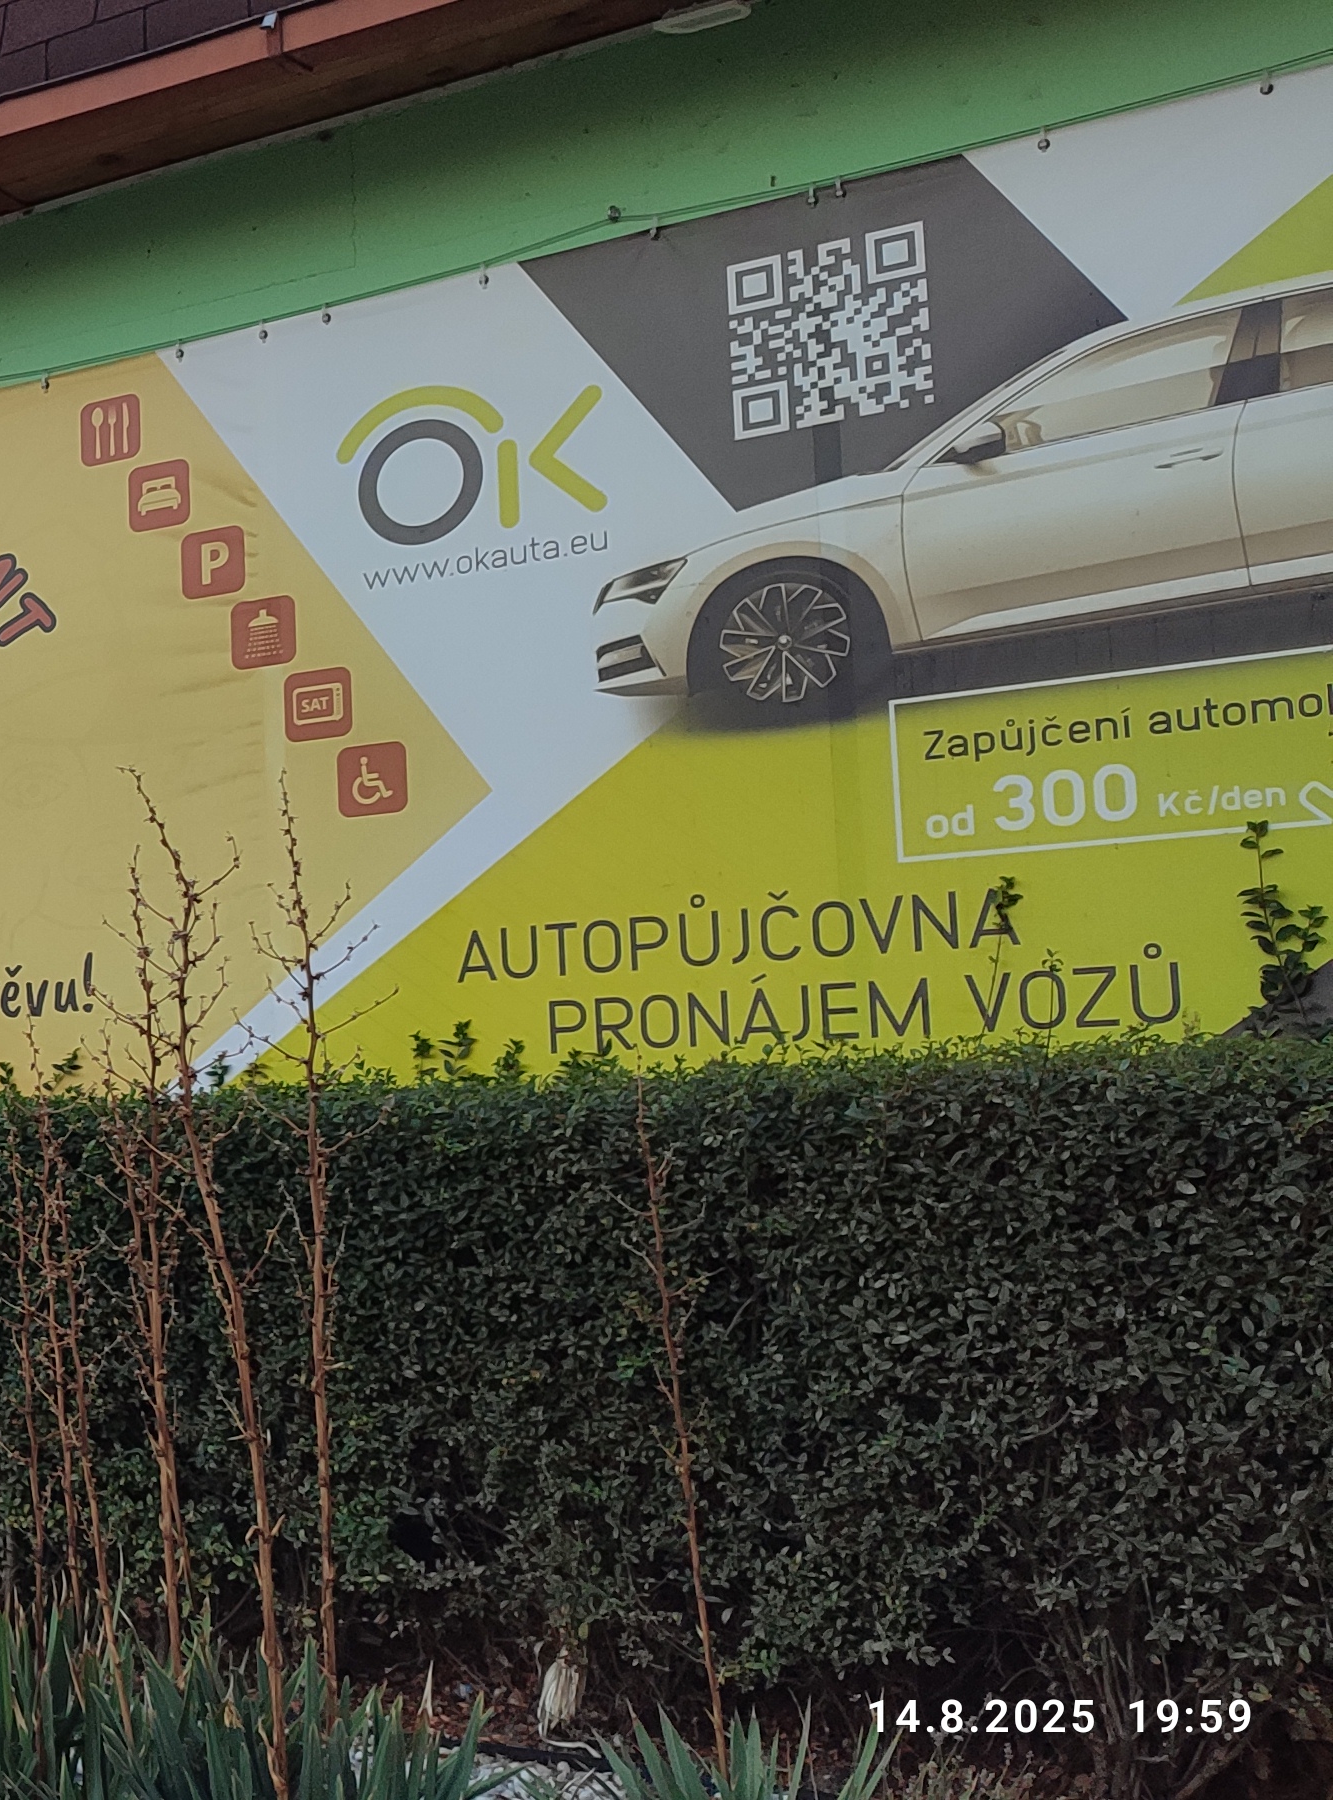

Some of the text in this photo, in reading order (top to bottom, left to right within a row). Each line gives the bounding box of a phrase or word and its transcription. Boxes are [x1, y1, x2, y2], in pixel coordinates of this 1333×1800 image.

[199, 540, 230, 586] P
[362, 530, 609, 590] www.okauta.eu
[300, 693, 329, 713] SAT
[923, 683, 1333, 762] Zapůjčení automo
[925, 763, 1287, 840] od 300 Kč/den
[457, 887, 1022, 984] AUTOPŮJČOVNA
[548, 942, 1182, 1055] PRONÁJEM VOZŮ
